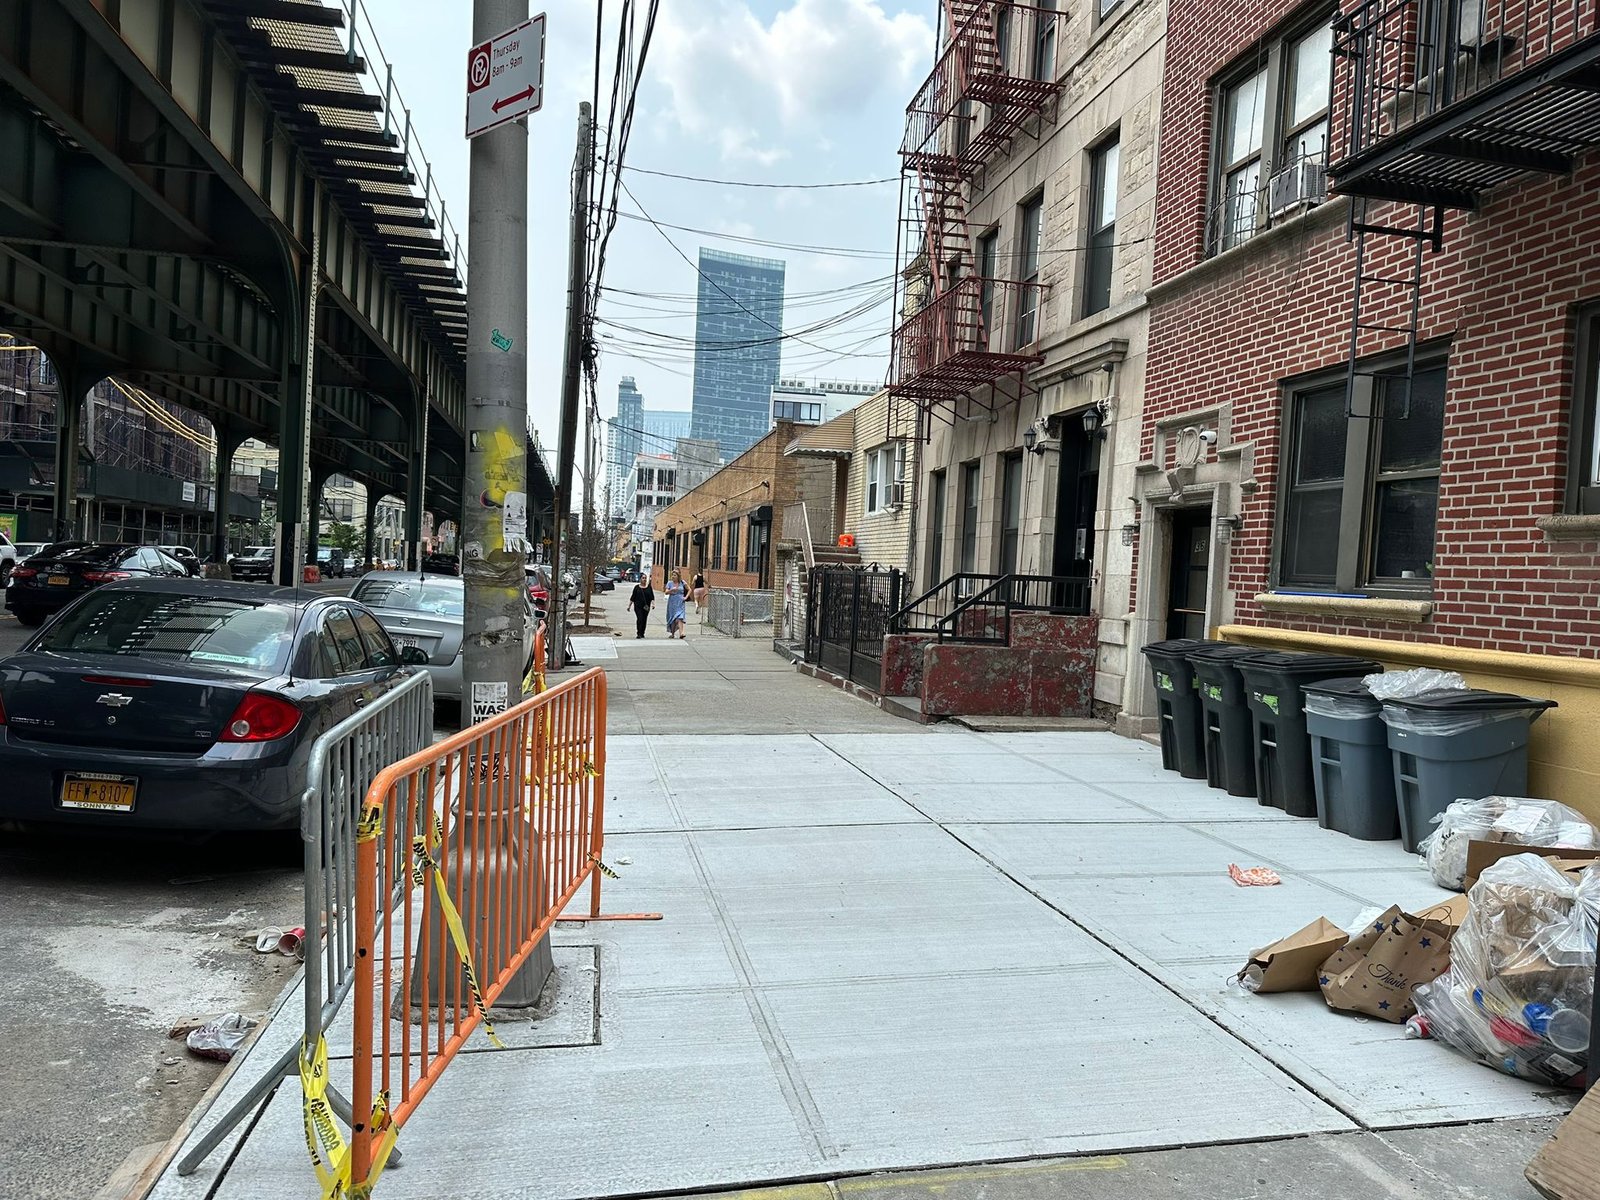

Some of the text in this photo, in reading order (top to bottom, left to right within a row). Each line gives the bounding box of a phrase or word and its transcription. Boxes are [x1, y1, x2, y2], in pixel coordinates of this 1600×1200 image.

[493, 40, 520, 60] Thursday
[492, 65, 505, 77] 8am
[510, 56, 523, 69] 9am
[474, 704, 505, 715] WAS
[1368, 963, 1408, 989] Thank
